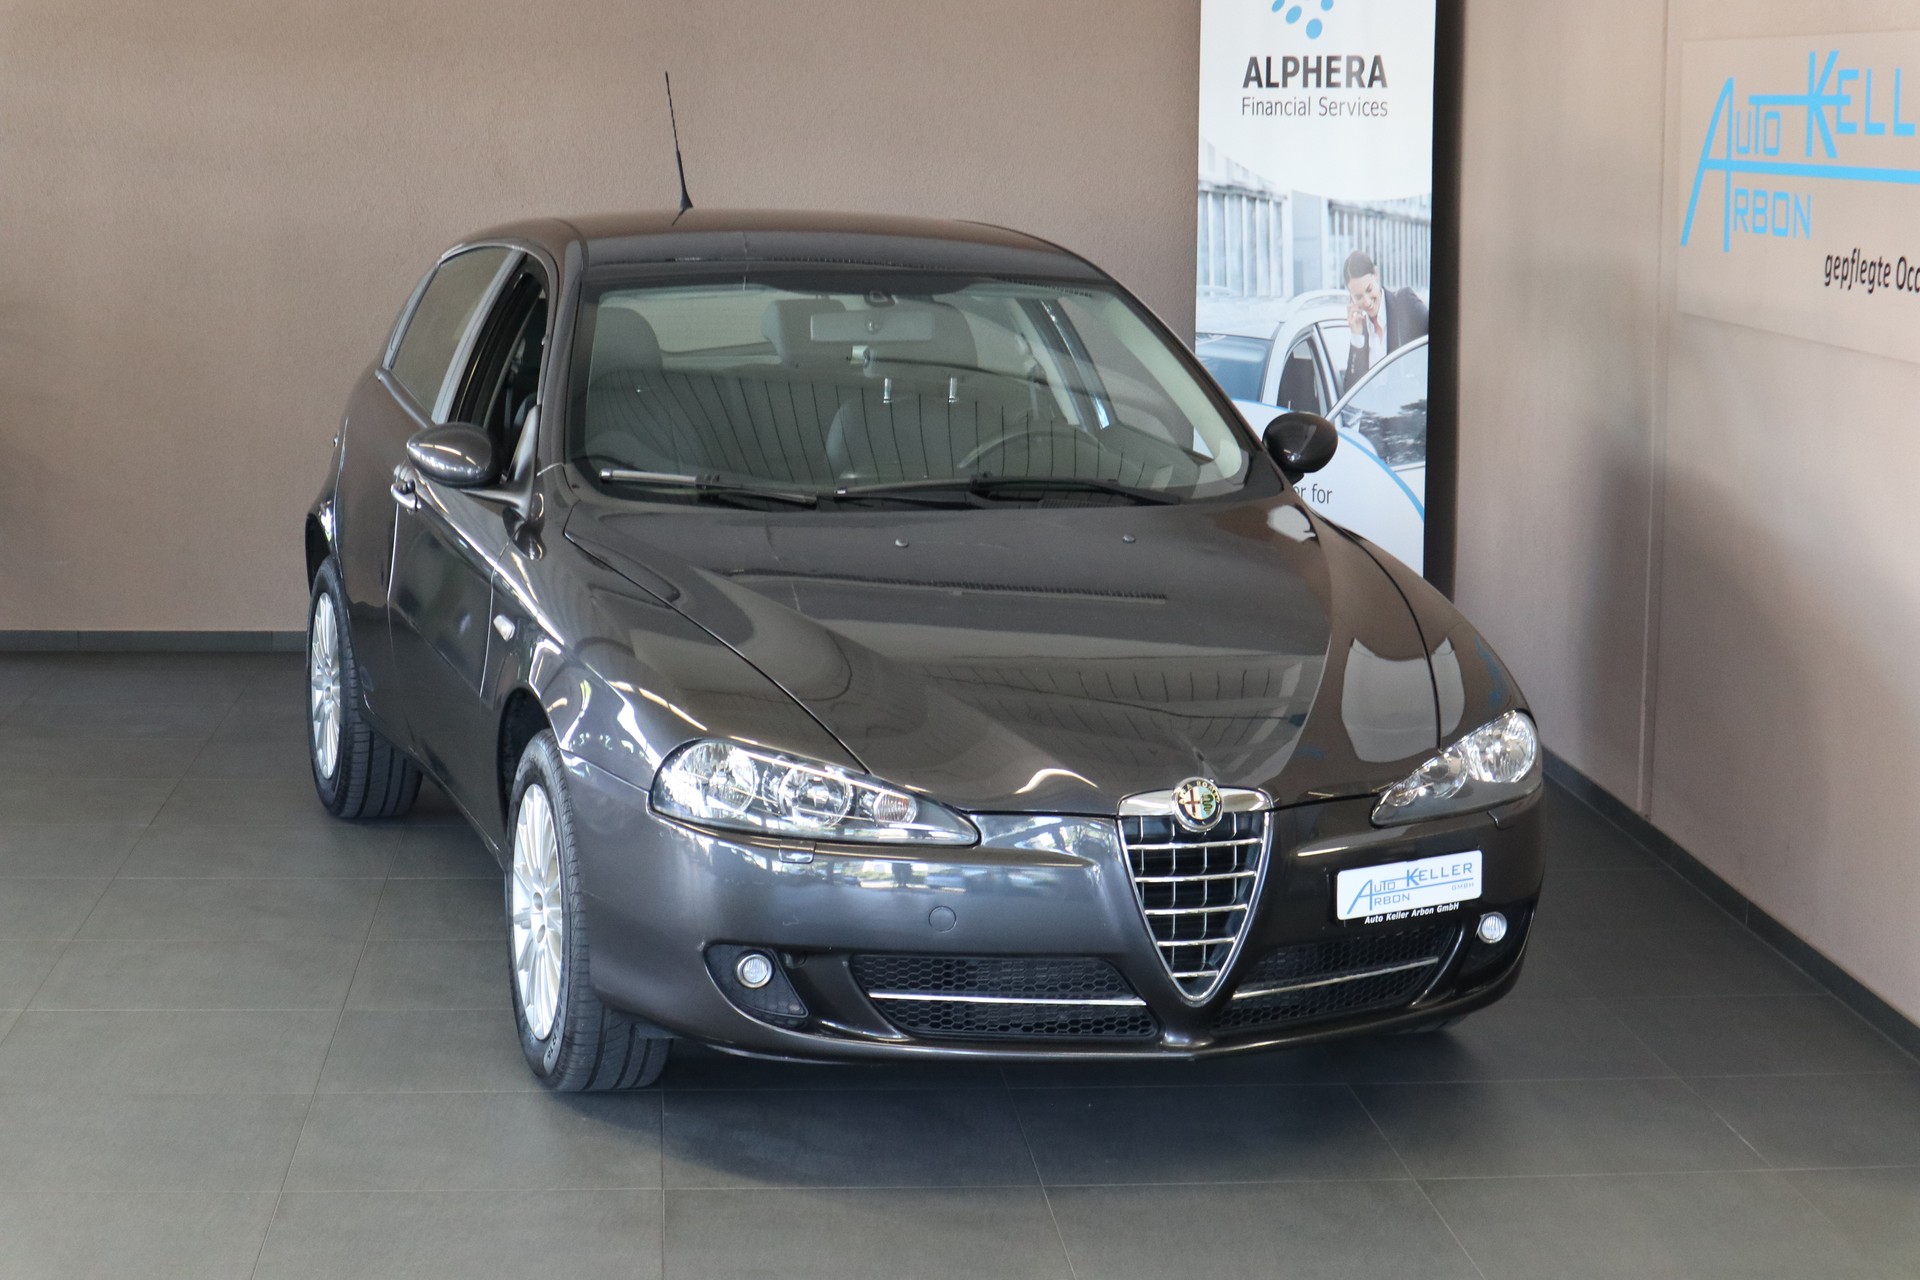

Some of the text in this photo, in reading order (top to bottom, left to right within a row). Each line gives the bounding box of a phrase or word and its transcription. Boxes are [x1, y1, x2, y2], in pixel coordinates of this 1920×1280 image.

[1242, 55, 1388, 89] ALPHERA
[1241, 96, 1388, 117] Financial Services
[1824, 247, 1892, 294] gepflegte
[1311, 483, 1333, 504] for
[1406, 862, 1473, 887] KELLER
[1364, 902, 1460, 925] Auto Keller Arbon GmbH
